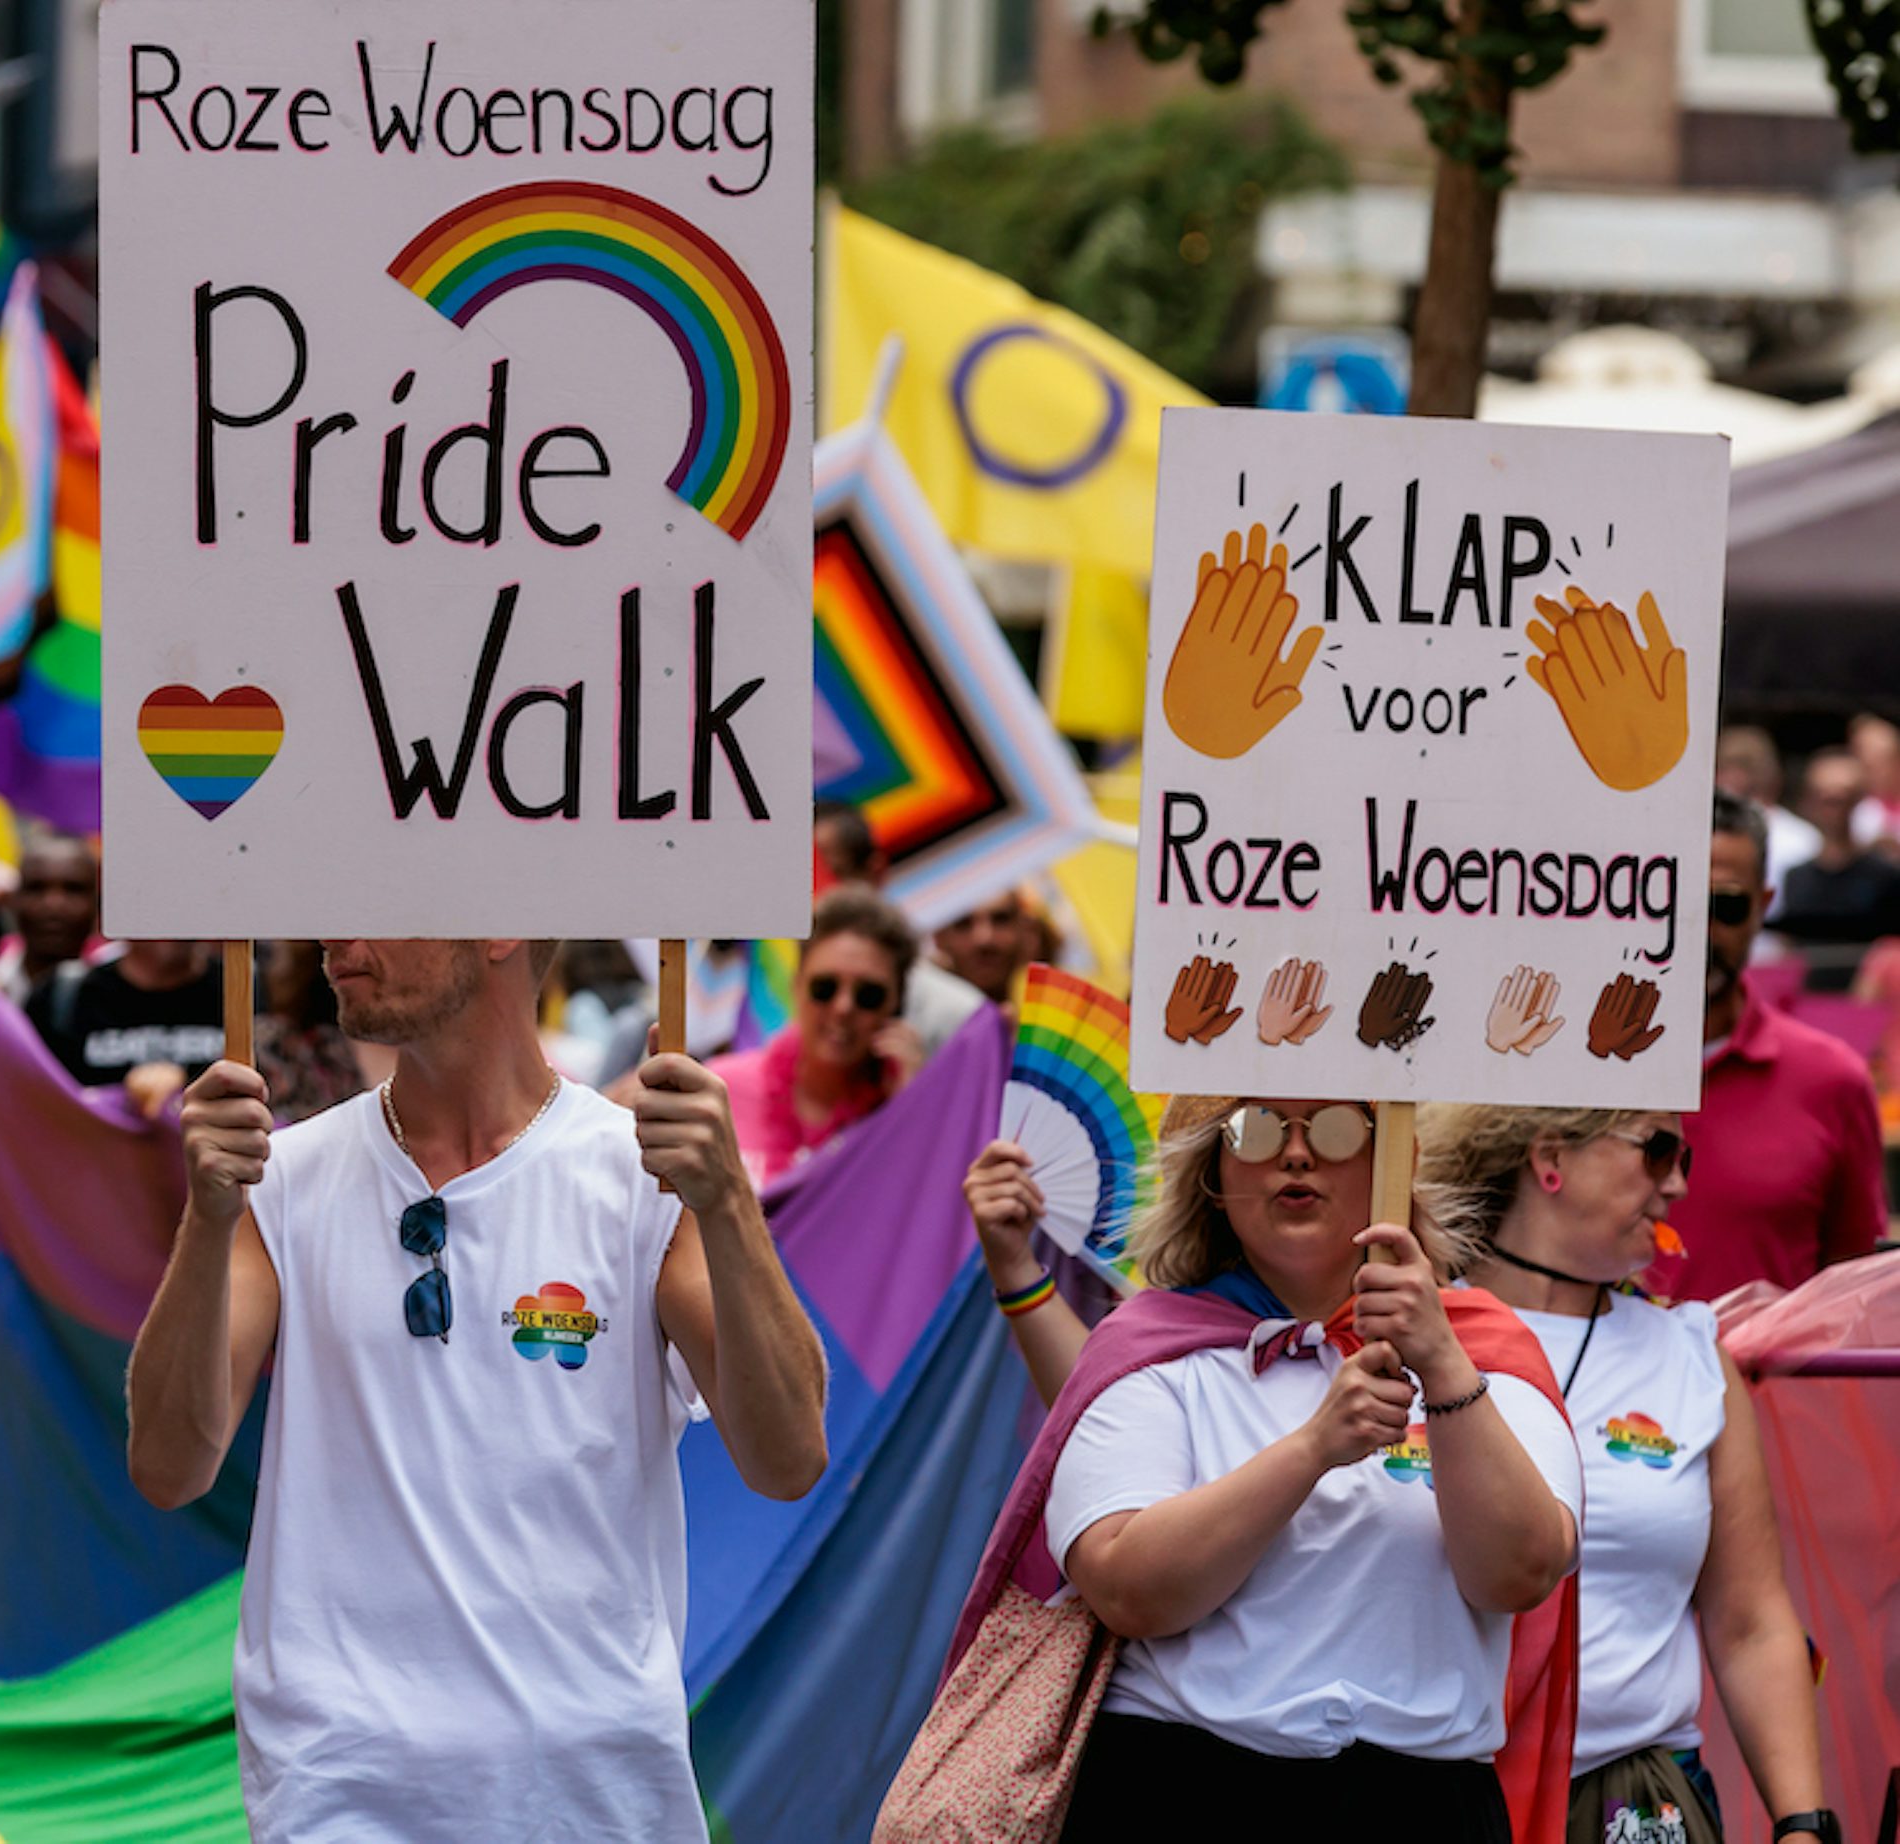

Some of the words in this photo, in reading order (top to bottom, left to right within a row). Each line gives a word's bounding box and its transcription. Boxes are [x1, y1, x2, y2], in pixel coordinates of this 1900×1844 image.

[130, 44, 332, 154] Roze
[194, 281, 611, 548] Pride
[1342, 684, 1488, 735] voor
[1158, 791, 1321, 910] Roze
[501, 1310, 537, 1328] ROZE
[541, 1312, 609, 1333] WOENSDAG
